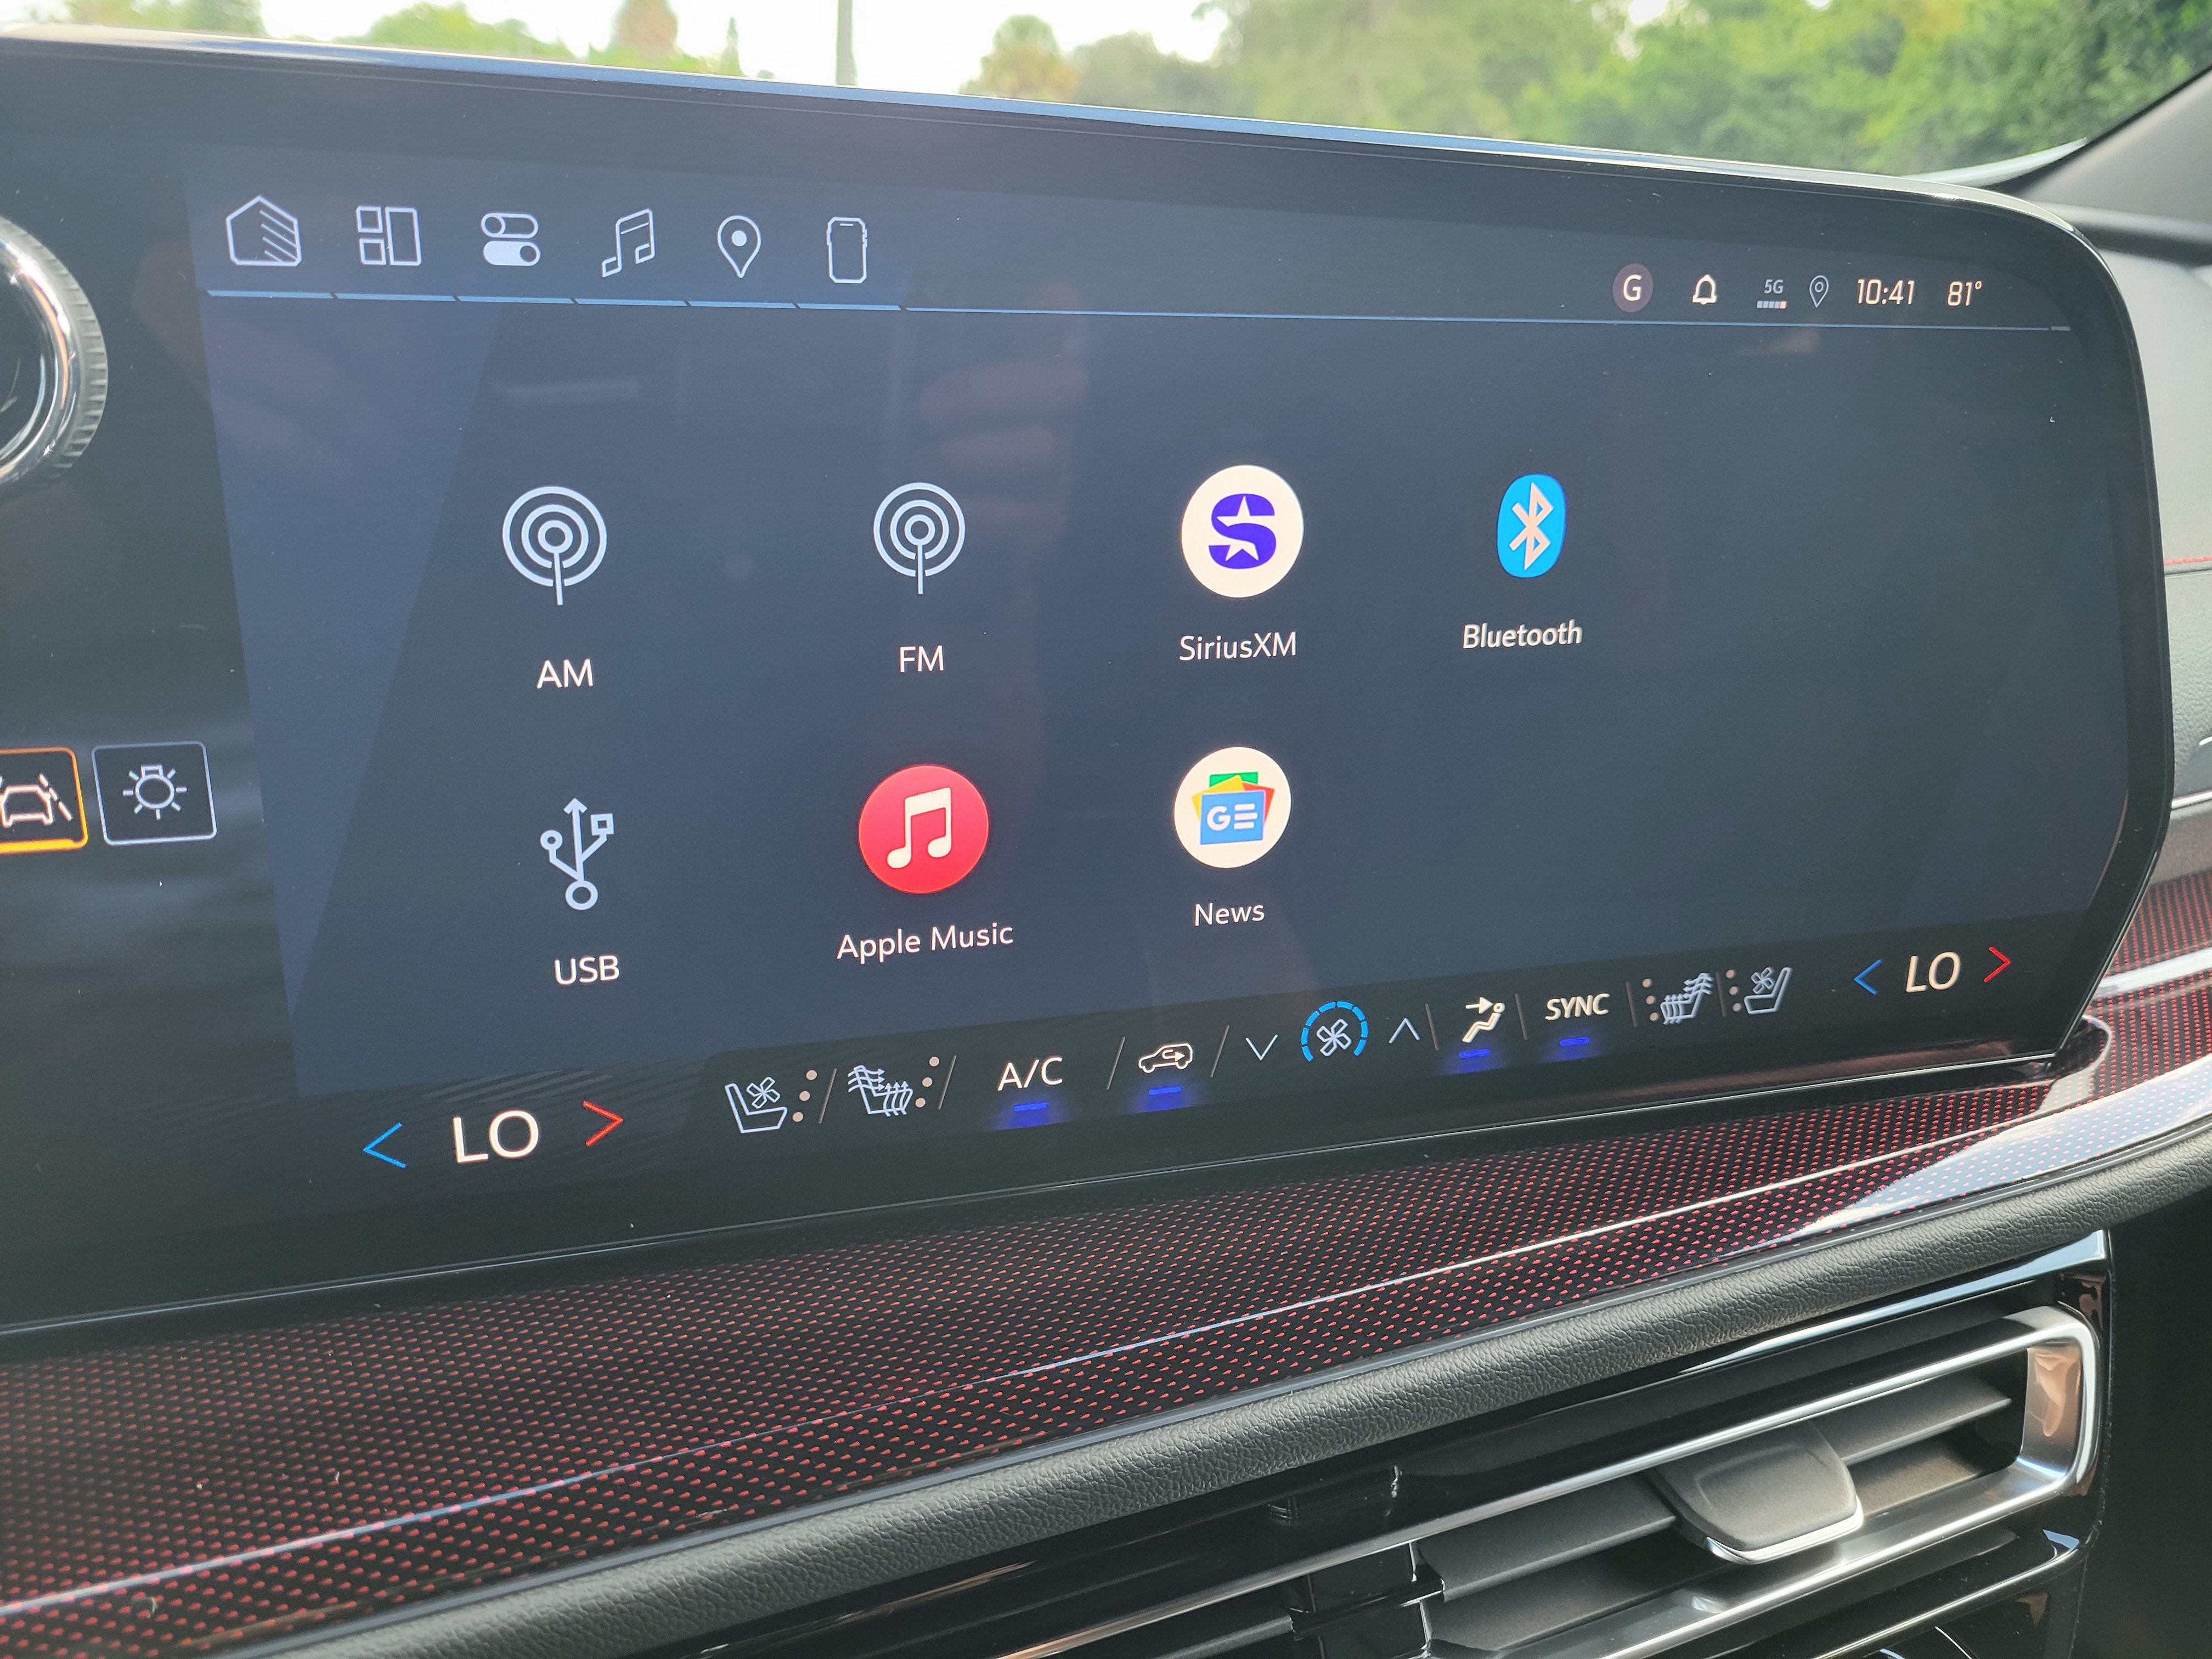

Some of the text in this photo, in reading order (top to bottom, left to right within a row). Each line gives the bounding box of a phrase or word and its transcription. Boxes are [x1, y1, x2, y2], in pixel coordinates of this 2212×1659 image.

[1623, 274, 1641, 301] G
[1763, 279, 1784, 295] 5G
[1858, 279, 1915, 305] 10:41
[1179, 631, 1296, 661] SiriusXM
[1463, 619, 1582, 648] Bluetooth
[537, 658, 593, 689] AM
[900, 645, 944, 673] FM
[1195, 902, 1265, 927] News
[837, 922, 1014, 964] Apple Music
[555, 955, 619, 985] USB
[1906, 951, 1961, 993] LO
[1545, 993, 1610, 1021] SYNC
[997, 1057, 1063, 1092] A/C
[453, 1110, 539, 1163] LO
